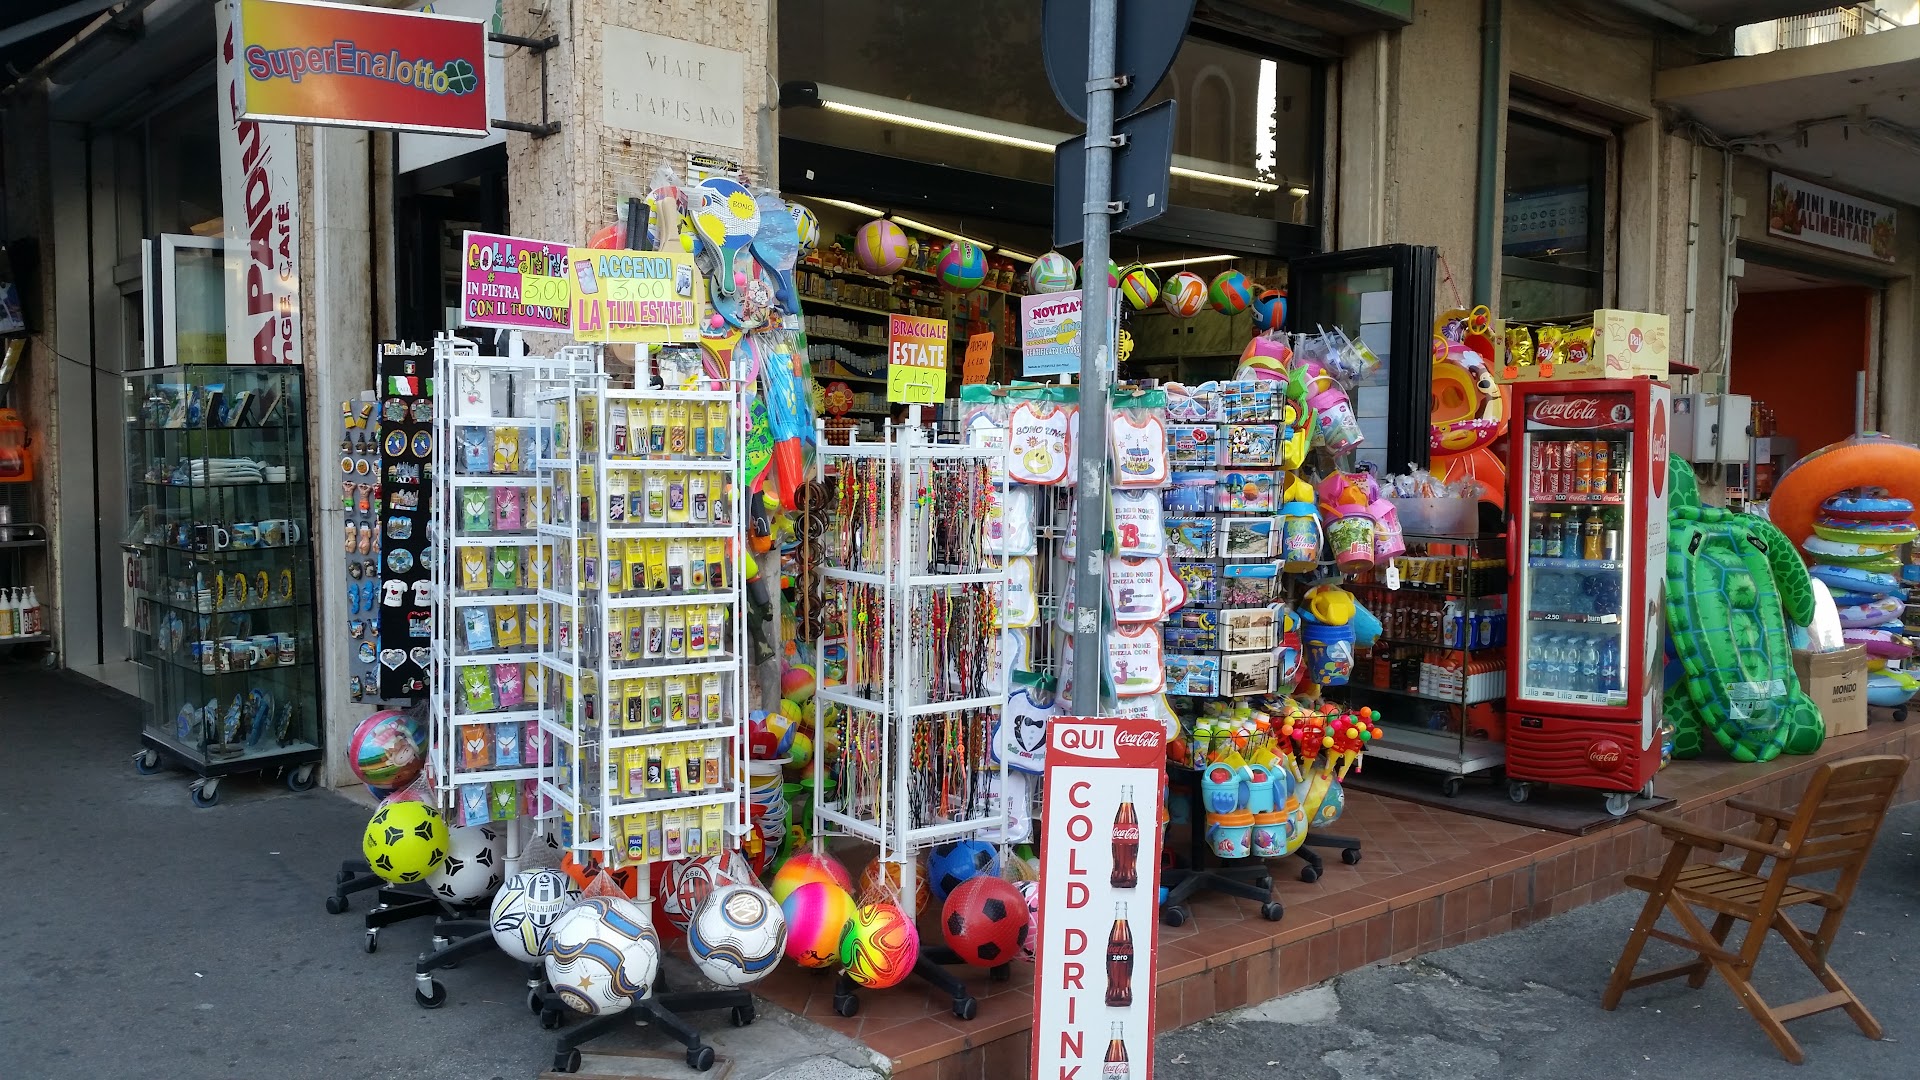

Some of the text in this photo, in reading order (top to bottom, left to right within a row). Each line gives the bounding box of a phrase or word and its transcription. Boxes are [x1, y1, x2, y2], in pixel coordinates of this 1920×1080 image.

[246, 40, 450, 94] SuperEnalotto
[646, 51, 707, 81] VIALE
[635, 92, 735, 128] PARISANO
[1796, 189, 1877, 227] MINI MARKET
[1799, 210, 1872, 245] ALIMENTARI
[598, 255, 673, 279] ACCENDI
[467, 281, 520, 300] IN PIETRA
[524, 276, 568, 303] 3,00
[614, 279, 665, 300] 3,00
[469, 301, 494, 317] CON
[496, 302, 508, 316] IL
[511, 302, 535, 317] TUO
[537, 306, 568, 326] NOME
[578, 299, 602, 331] LA
[606, 300, 636, 328] TUA
[640, 300, 682, 327] ESTATE
[893, 318, 947, 340] BRACCIALE
[1027, 320, 1082, 339] BAVAGLINO
[1629, 335, 1642, 346] Paj
[892, 341, 944, 368] ESTATE
[1027, 346, 1059, 358] CERTIFICATO
[1537, 346, 1554, 360] Paj
[1570, 348, 1585, 360] Paj
[1532, 398, 1600, 420] Coca-Cola
[1557, 690, 1572, 700] Lilia
[1592, 693, 1607, 703] Lilia
[1832, 682, 1857, 696] MONDO
[1129, 705, 1149, 714] NOME
[1060, 728, 1159, 751] QUI Coca-Cola
[1589, 750, 1619, 763] Coca-Cola
[1112, 826, 1140, 841] Coca-Cola
[1066, 781, 1093, 910] COLD
[1112, 954, 1128, 962] zero
